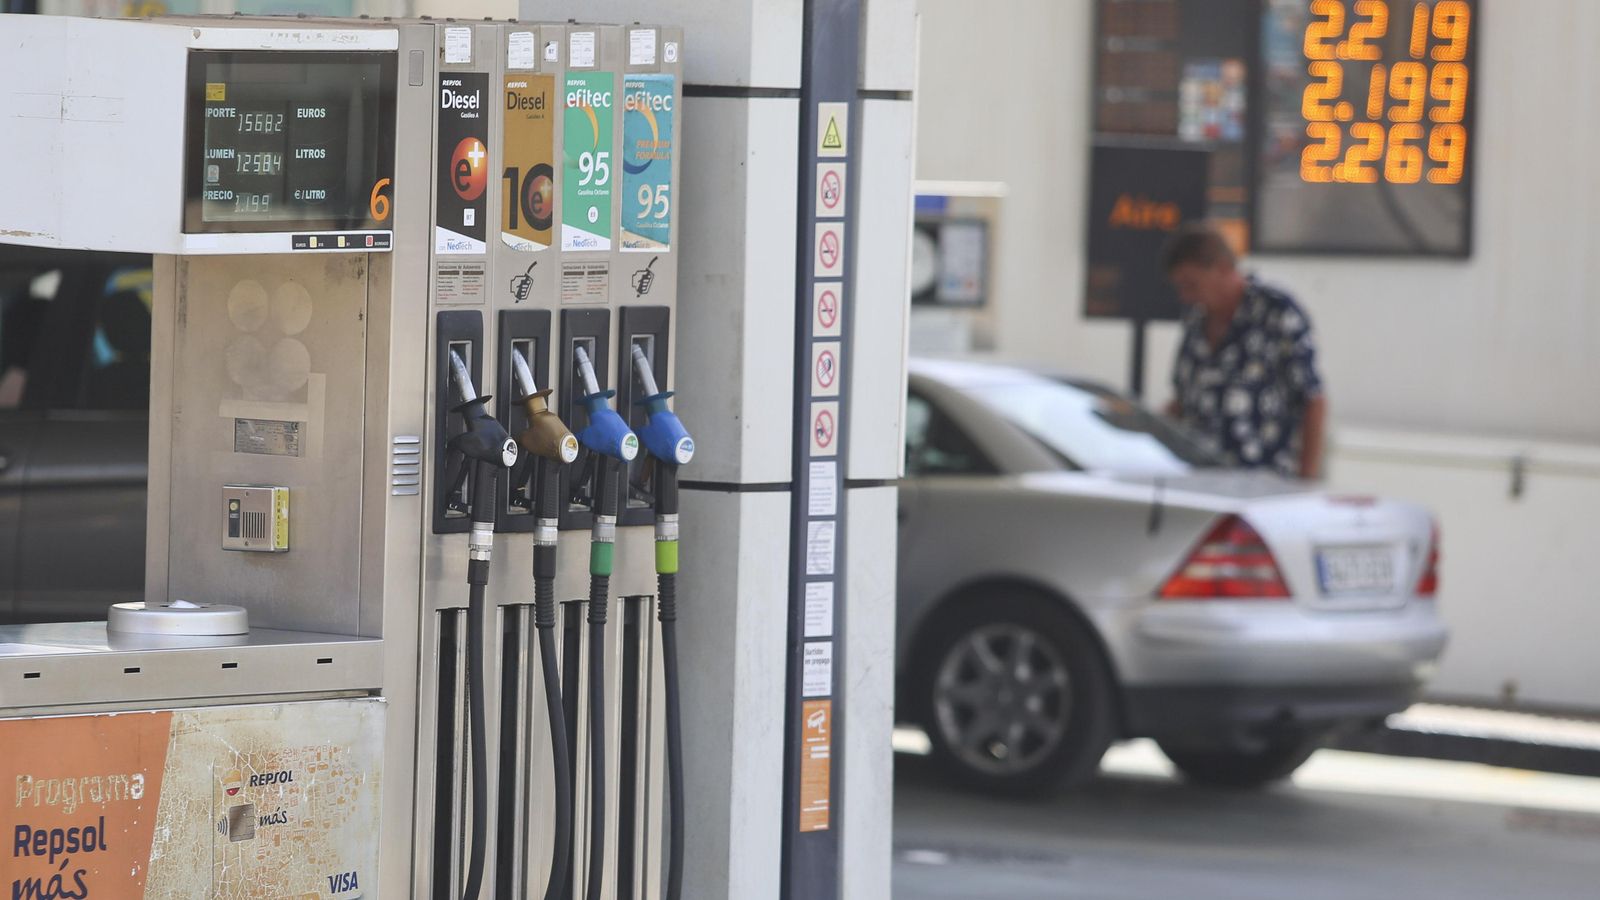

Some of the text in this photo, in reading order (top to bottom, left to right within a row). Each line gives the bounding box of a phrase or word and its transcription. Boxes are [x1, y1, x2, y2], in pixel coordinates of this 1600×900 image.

[1303, 0, 1470, 62] 2.219
[441, 89, 480, 109] Diesel
[507, 92, 545, 110] Diesel
[566, 89, 611, 108] efitec
[625, 91, 672, 111] efitec
[1301, 60, 1469, 123] 2.199
[297, 108, 325, 118] EUROS
[295, 149, 326, 159] LITROS
[1300, 121, 1468, 184] 2.269
[578, 152, 609, 186] 95
[203, 190, 233, 200] PRECIO
[370, 178, 390, 221] 6
[637, 184, 670, 219] 95
[249, 770, 294, 788] REPSOL
[15, 773, 145, 814] Programa
[259, 810, 288, 827] más
[13, 816, 107, 864] Repsol
[11, 858, 89, 900] más
[327, 871, 359, 894] VISA
